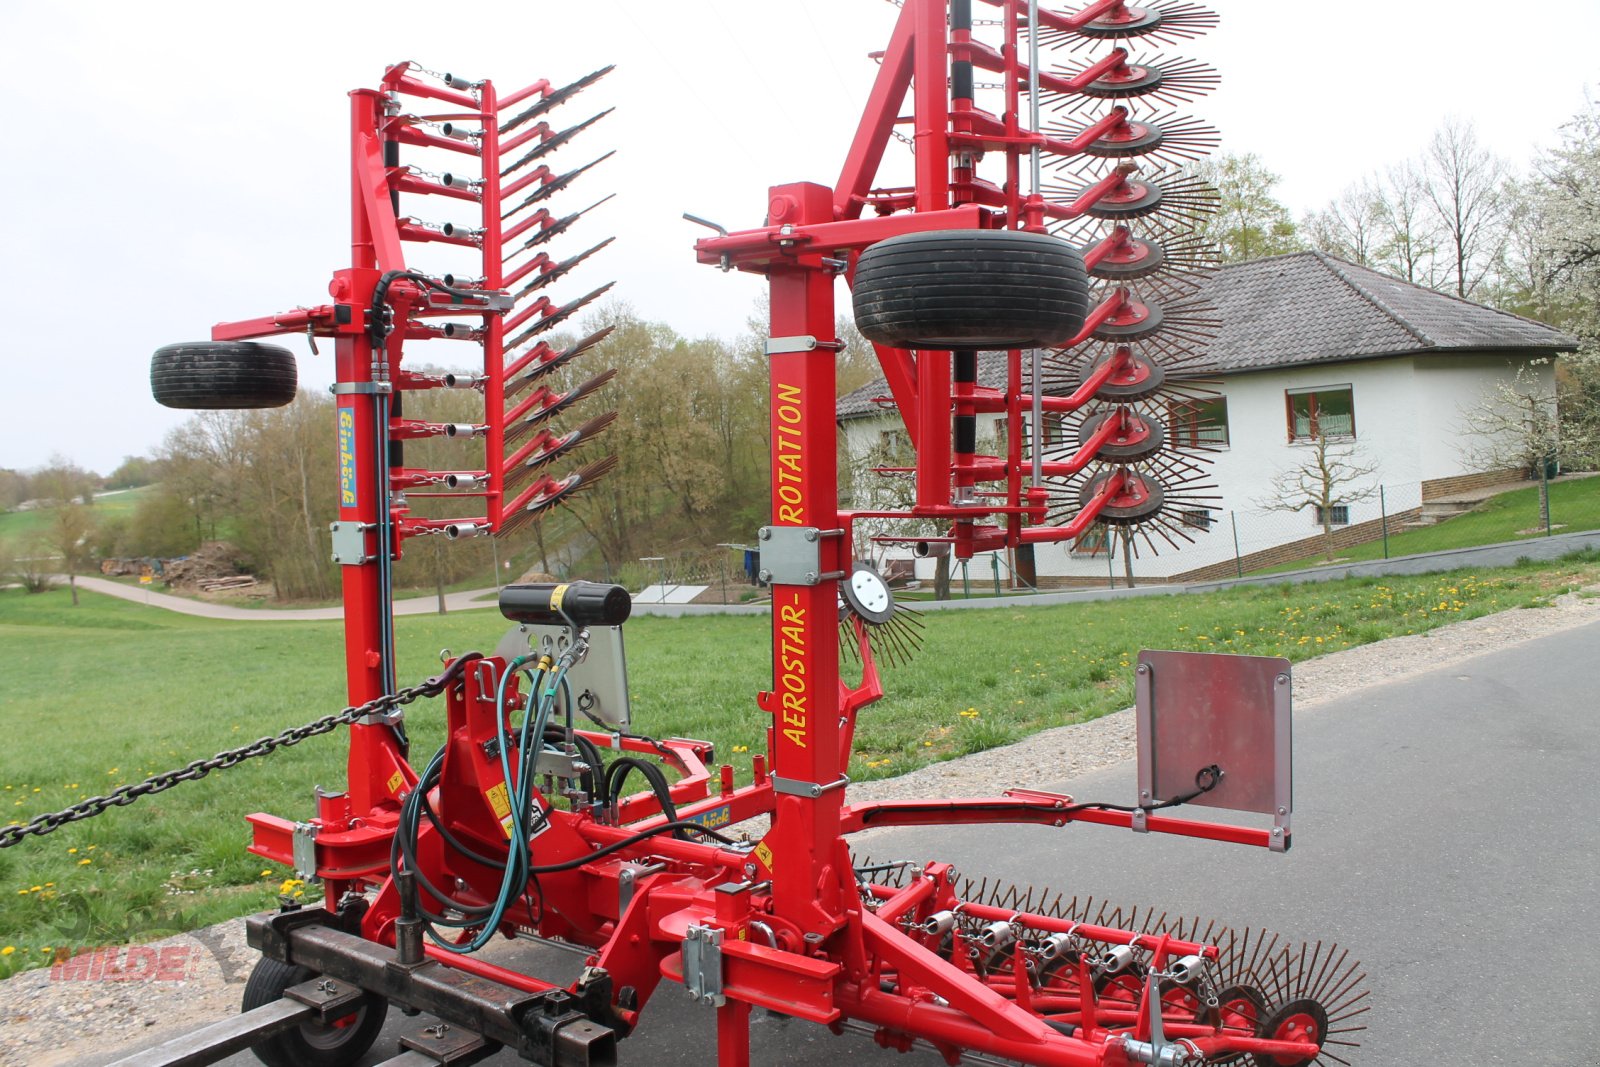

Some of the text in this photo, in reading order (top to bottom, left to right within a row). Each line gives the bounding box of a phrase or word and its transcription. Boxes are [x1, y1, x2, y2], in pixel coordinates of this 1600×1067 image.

[340, 411, 354, 503] Einböck
[778, 383, 807, 748] AEROSTAR- ROTATION
